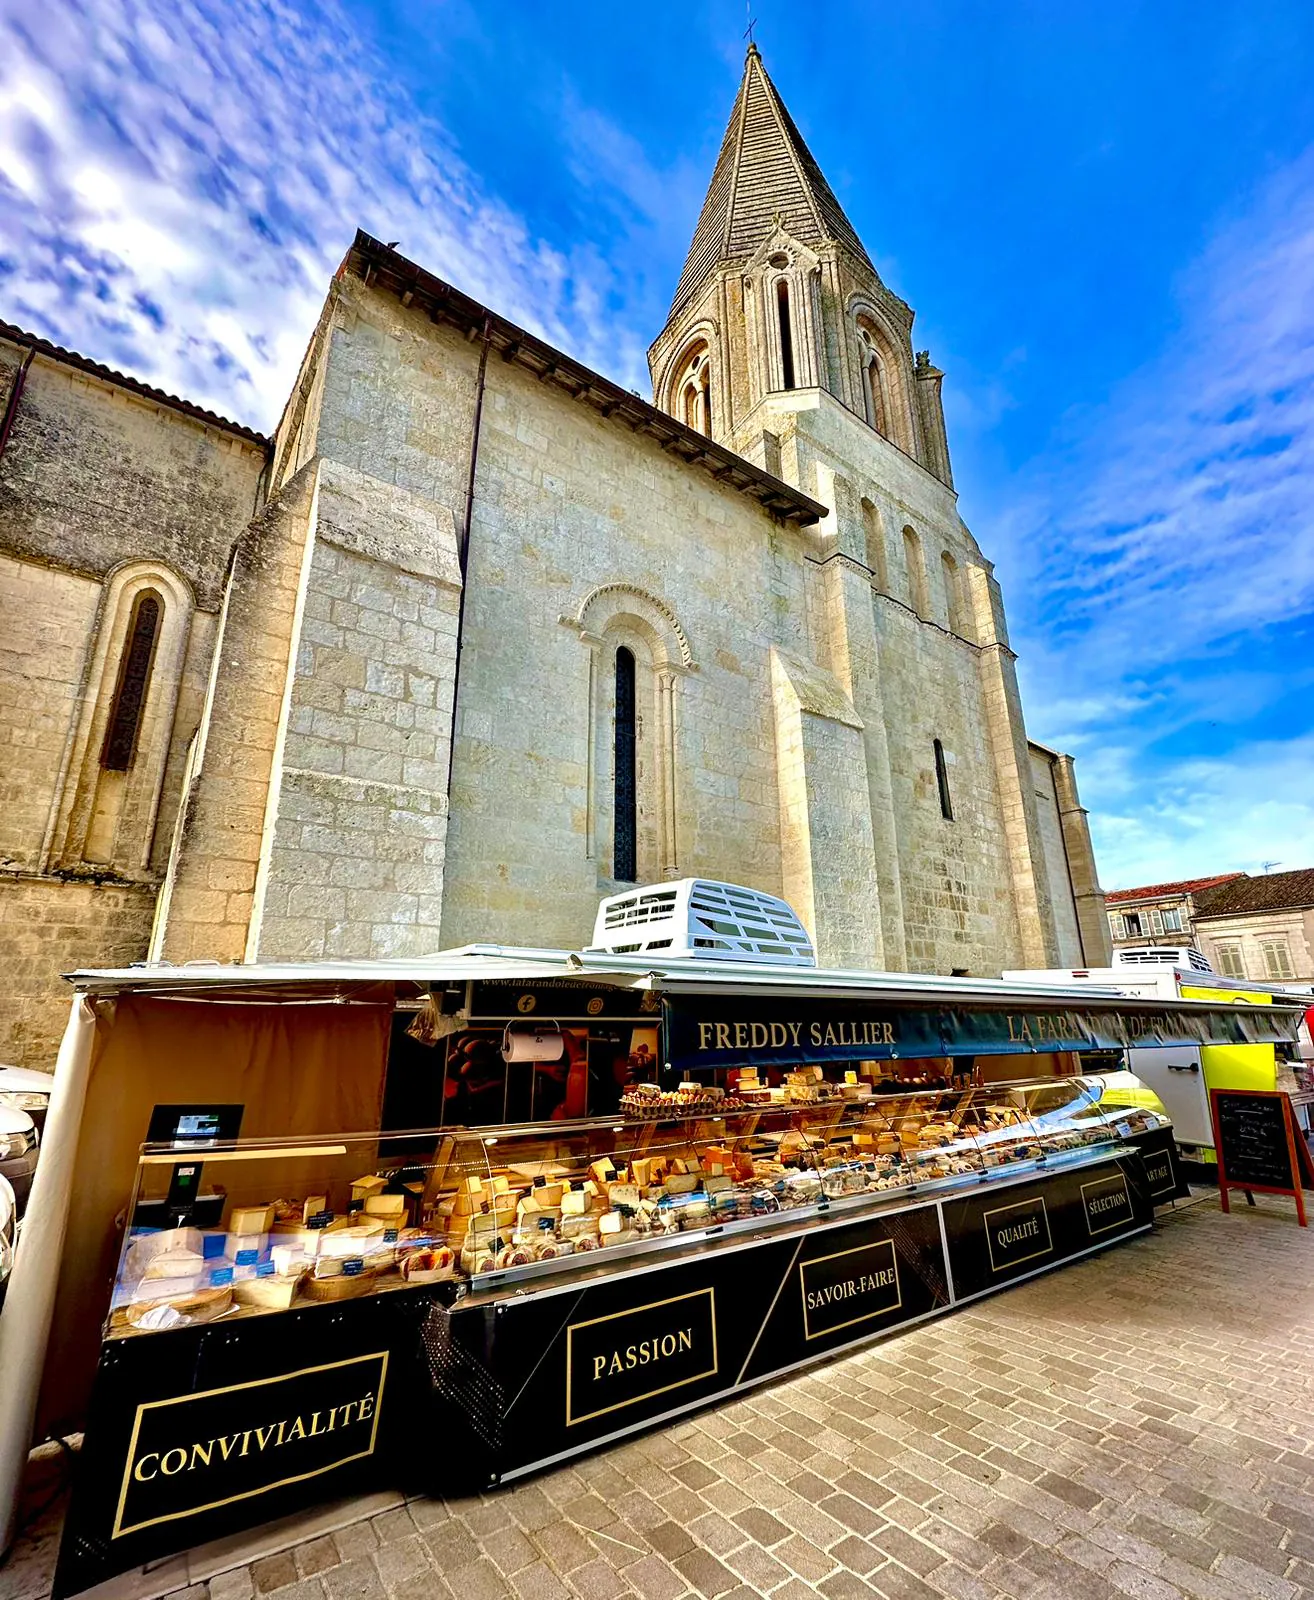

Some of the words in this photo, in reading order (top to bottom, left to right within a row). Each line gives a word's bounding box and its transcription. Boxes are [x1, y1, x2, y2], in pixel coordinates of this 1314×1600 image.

[698, 1022, 802, 1049] FREDDY
[810, 1022, 896, 1047] SALLIER
[1007, 1016, 1033, 1042] LA
[1089, 1192, 1126, 1215] SÉLECTION
[997, 1216, 1040, 1248] QUALITÉ
[807, 1267, 897, 1311] SAVOIR-FAIRE
[591, 1327, 694, 1382] PASSION
[134, 1391, 375, 1482] CONVIVIALITÉ
